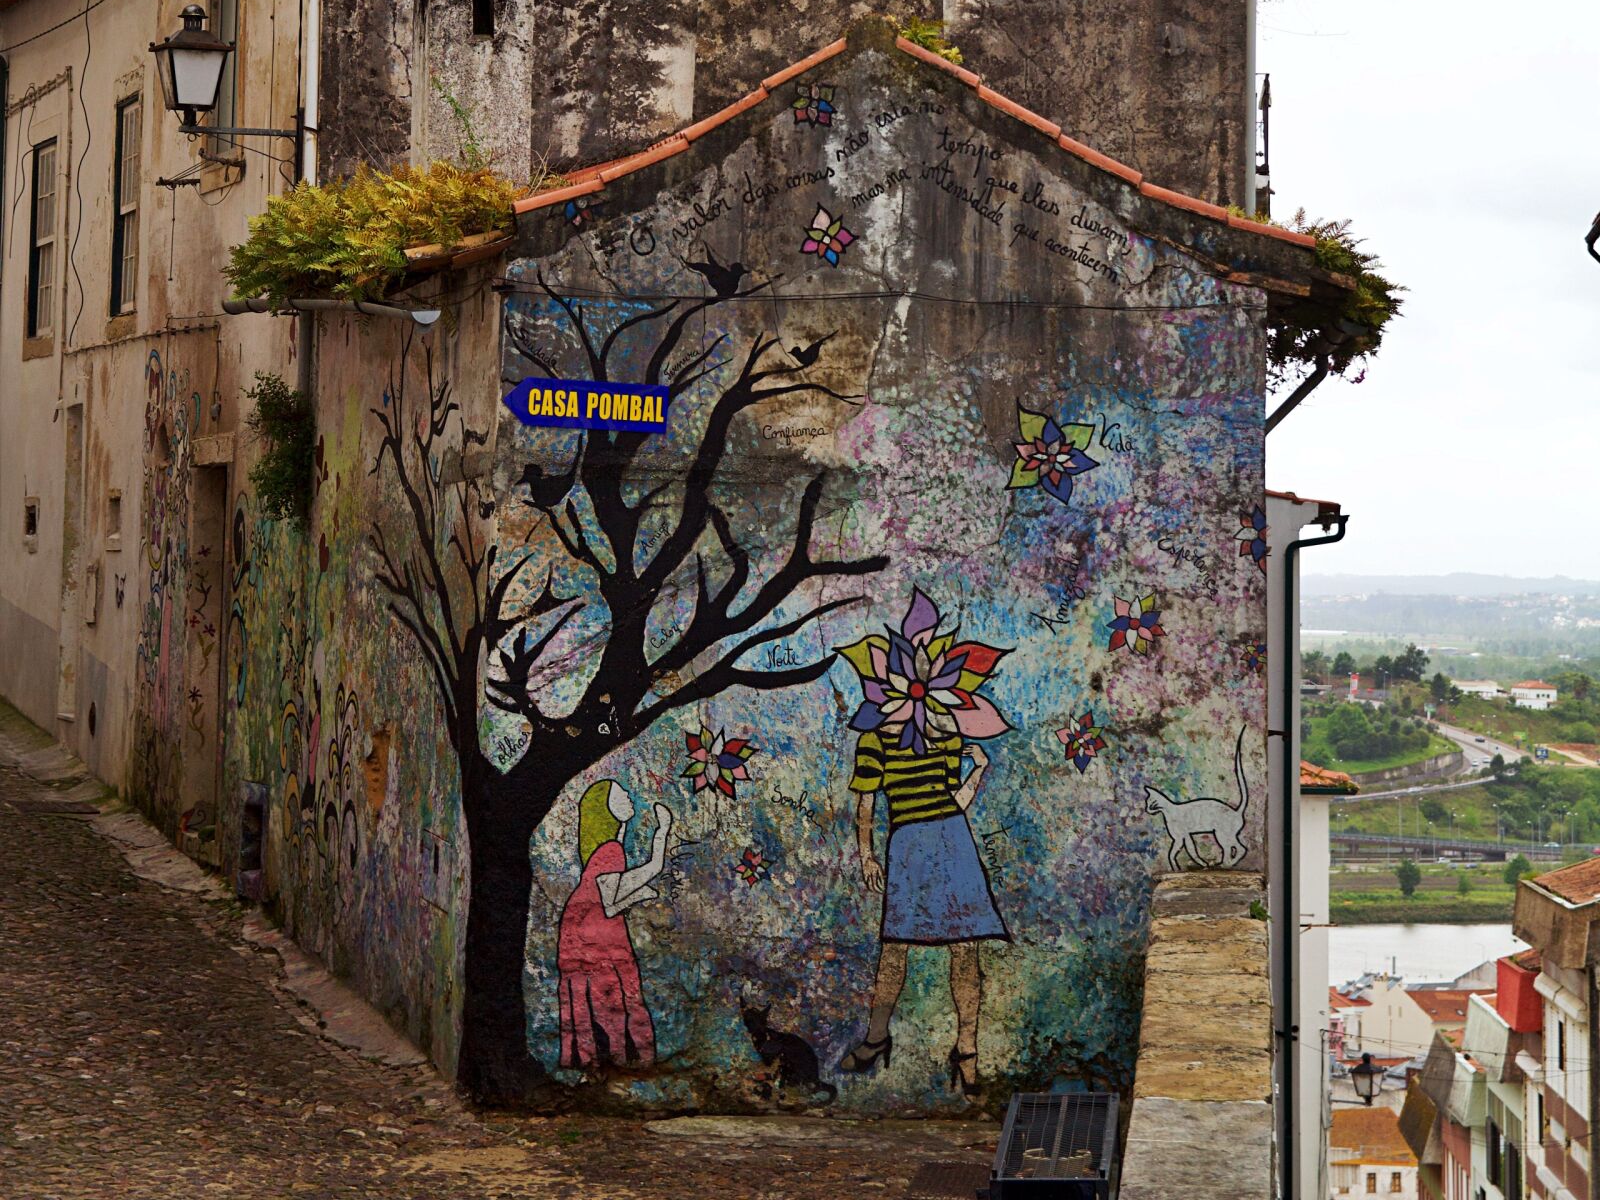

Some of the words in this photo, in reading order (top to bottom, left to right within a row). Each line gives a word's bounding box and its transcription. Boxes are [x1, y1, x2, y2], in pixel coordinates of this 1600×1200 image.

[672, 198, 732, 241] valor
[742, 171, 778, 203] das
[786, 166, 835, 189] coisas
[836, 131, 870, 162] não
[936, 126, 1005, 178] tempo
[985, 176, 1019, 205] que
[1022, 184, 1060, 216] elas
[851, 182, 885, 209] mas
[885, 168, 912, 189] na
[919, 161, 1005, 227] intensidade
[1013, 221, 1040, 247] que
[513, 326, 559, 374] Saudade
[528, 388, 579, 418] CASA
[586, 392, 665, 423] POMBAL
[762, 425, 829, 446] Confiança
[1096, 412, 1136, 453] Vida
[1157, 532, 1219, 602] Esperança
[650, 622, 682, 649] Calor
[765, 642, 803, 670] Noite
